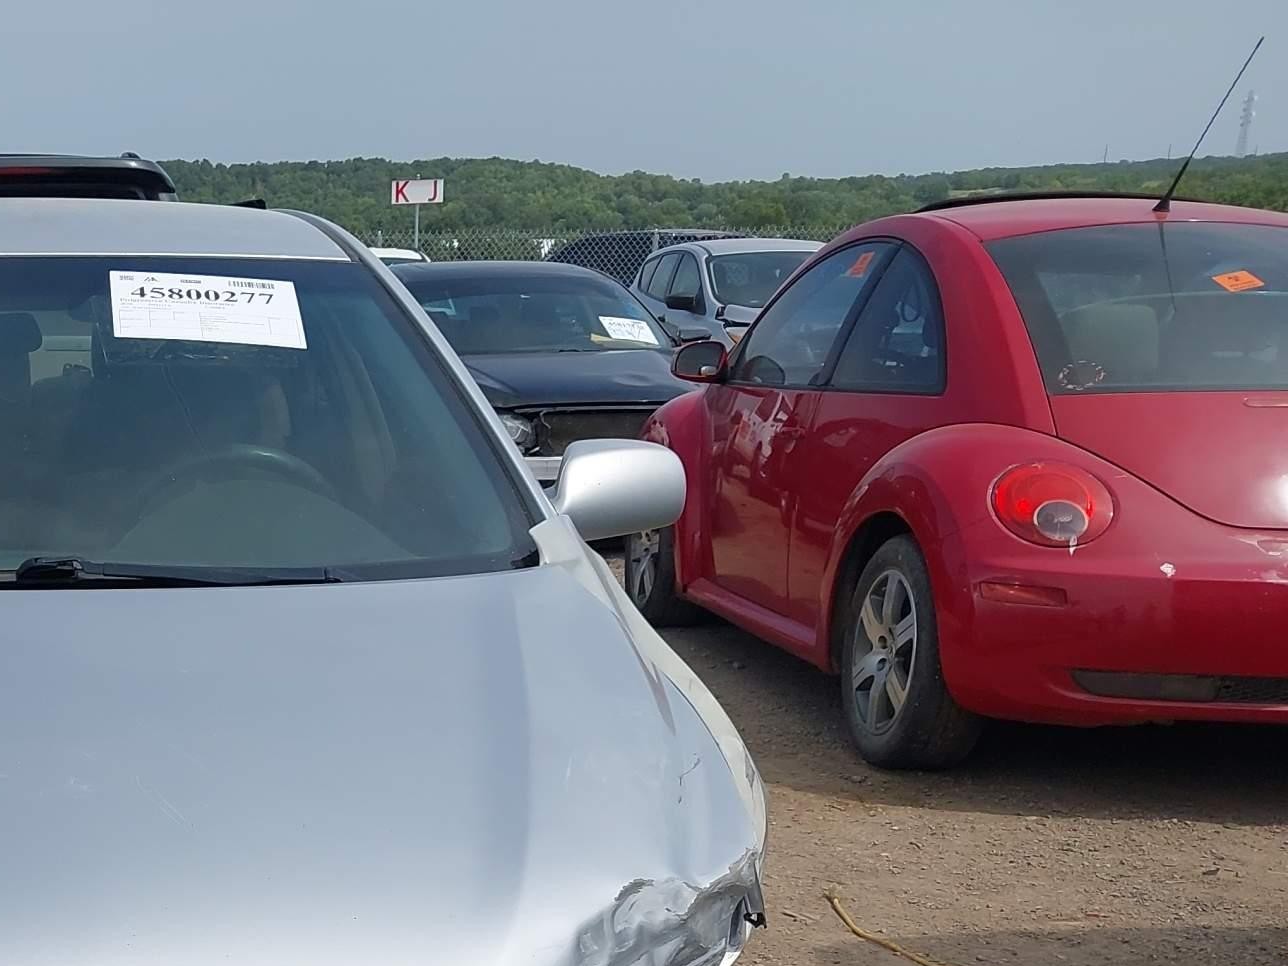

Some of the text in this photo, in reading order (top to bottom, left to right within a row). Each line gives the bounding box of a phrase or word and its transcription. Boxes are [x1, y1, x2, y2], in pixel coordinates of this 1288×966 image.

[395, 180, 438, 203] K J
[130, 286, 274, 305] 45800277
